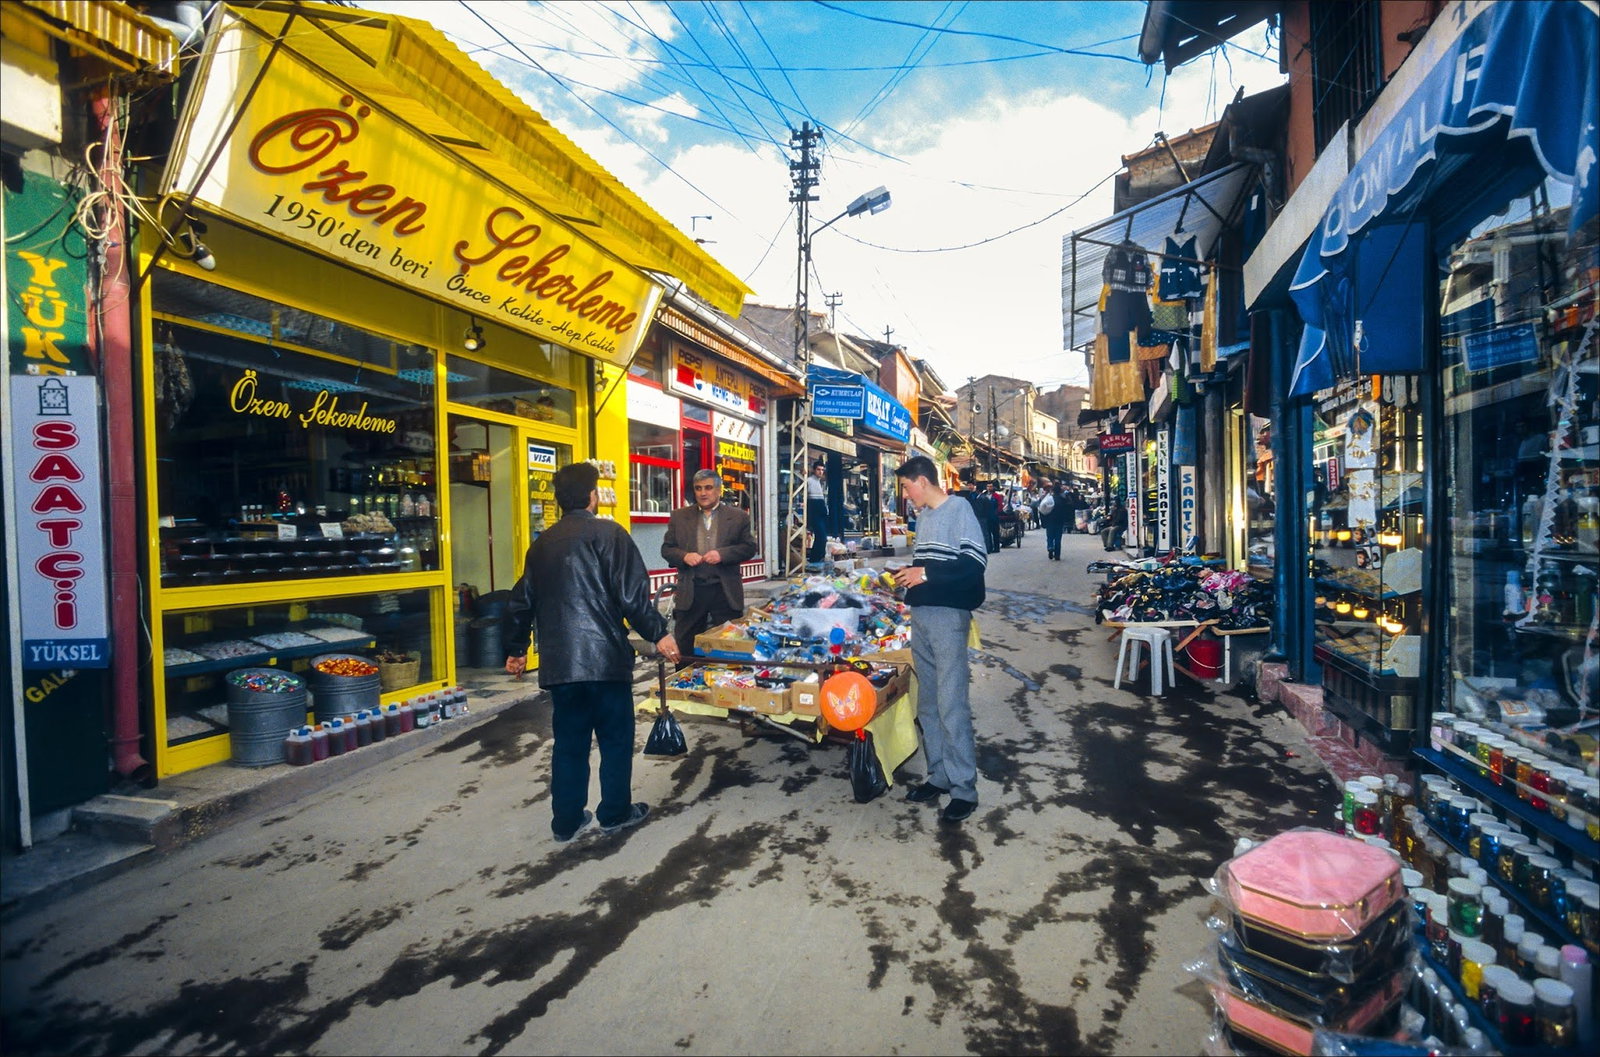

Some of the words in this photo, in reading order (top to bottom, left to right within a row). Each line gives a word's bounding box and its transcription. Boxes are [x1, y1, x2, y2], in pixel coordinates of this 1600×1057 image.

[249, 95, 427, 237] Özen
[453, 206, 638, 335] Şekerleme
[263, 194, 381, 259] 1950'den
[389, 247, 433, 279] beri
[18, 251, 70, 376] YÜK
[446, 274, 491, 304] Önce
[678, 348, 703, 371] PEPSI
[230, 369, 292, 420] Özen
[299, 389, 397, 434] Şekerleme
[533, 452, 551, 464] VISA
[29, 420, 86, 630] SAATÇİ
[31, 641, 101, 661] YÜKSEL
